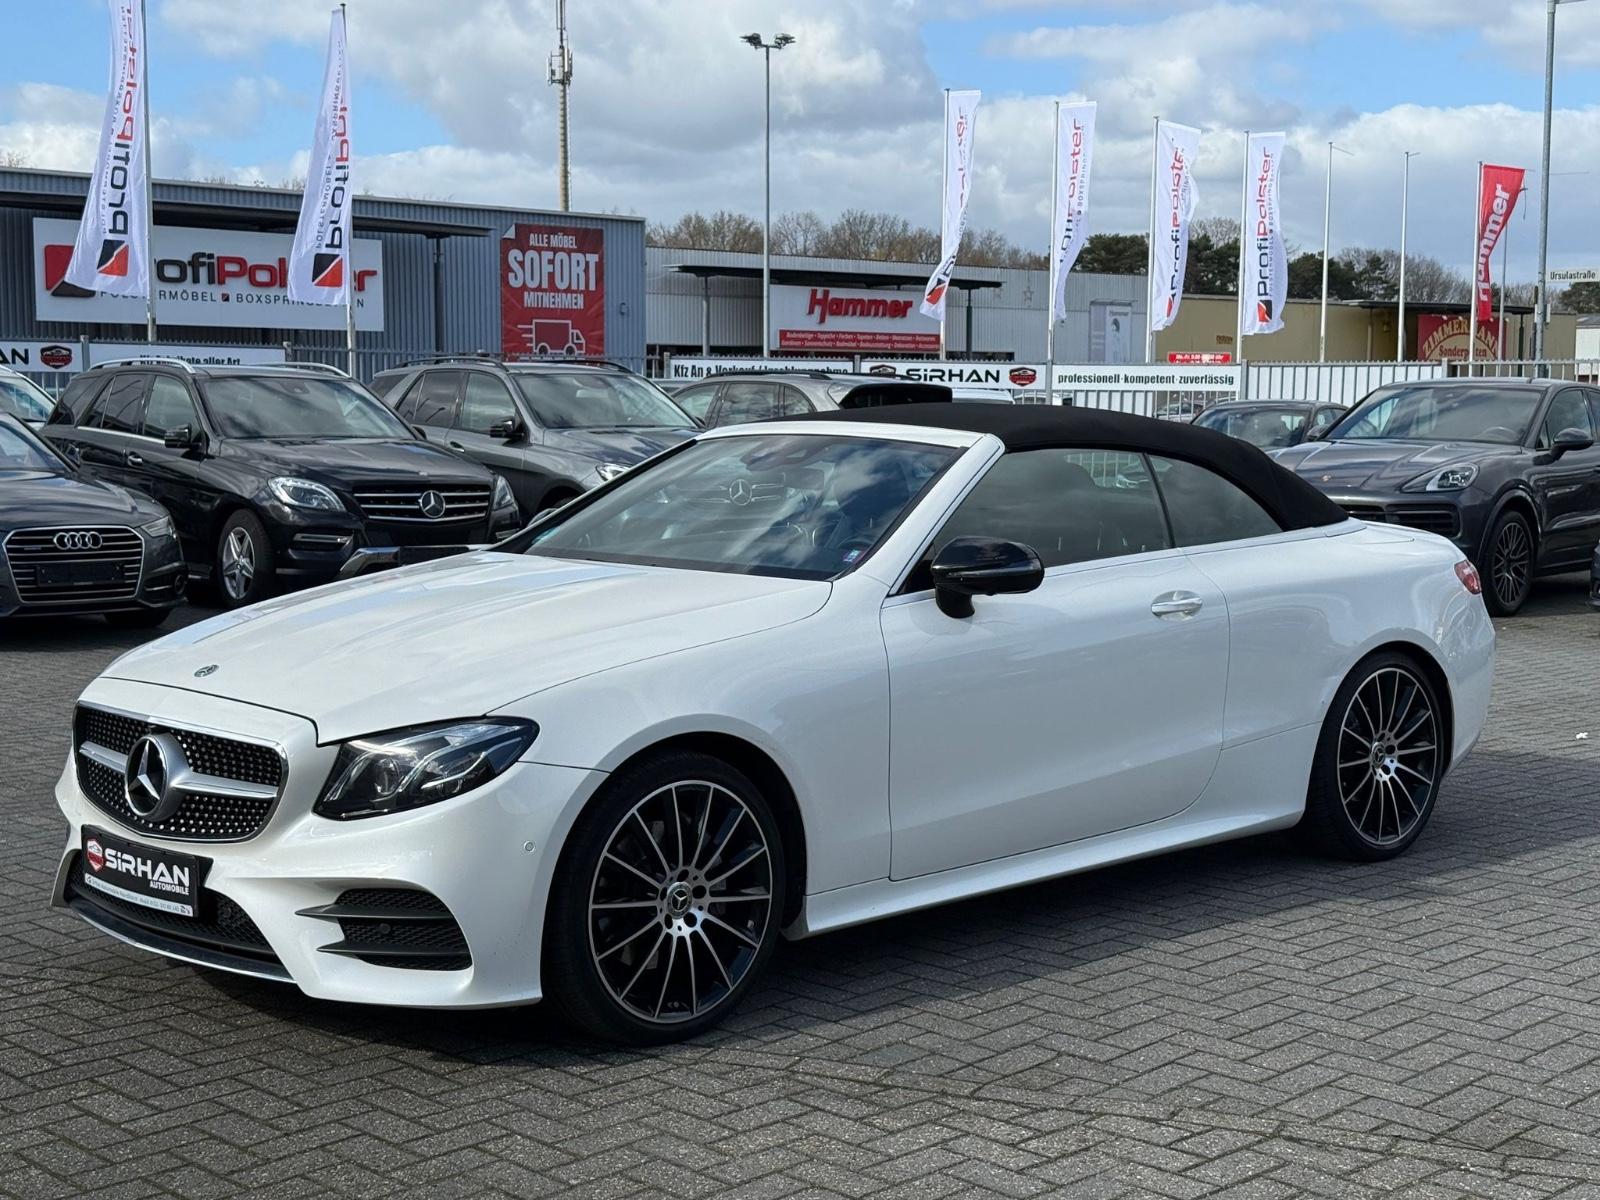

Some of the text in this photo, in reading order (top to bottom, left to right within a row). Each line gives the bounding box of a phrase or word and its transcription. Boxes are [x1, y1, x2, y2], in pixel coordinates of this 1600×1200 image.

[529, 232, 578, 249] ALLE MÖBEL
[507, 248, 600, 291] SOFORT
[1550, 270, 1596, 280] Ursulastraße
[524, 291, 584, 309] MITNEHMEN
[807, 288, 913, 324] Hammer
[227, 357, 241, 366] Art
[674, 364, 689, 378] Kfz
[690, 364, 704, 378] An
[1058, 373, 1235, 386] professionell kompetent zuverlässig
[149, 880, 190, 896] AUTOMOBILE
